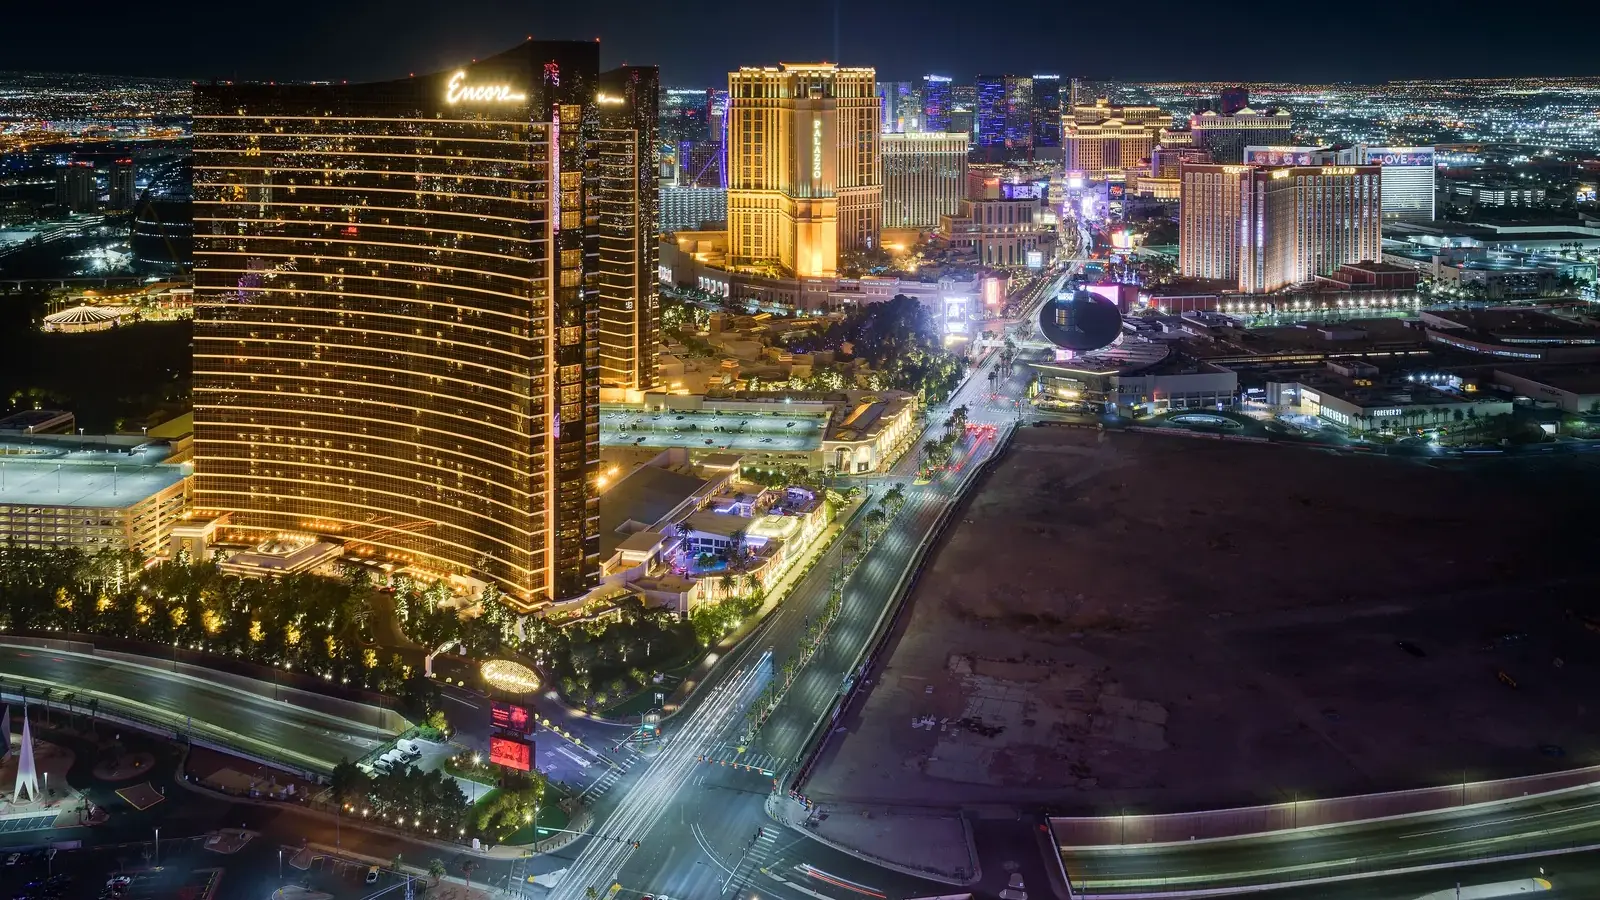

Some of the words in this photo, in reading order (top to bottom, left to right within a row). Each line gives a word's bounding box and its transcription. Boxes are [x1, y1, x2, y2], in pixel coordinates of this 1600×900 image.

[447, 71, 525, 103] Encore
[1380, 154, 1407, 165] LOVE
[1321, 167, 1356, 175] ISLAND
[1321, 406, 1342, 422] FOREVER
[484, 664, 540, 688] Encore
